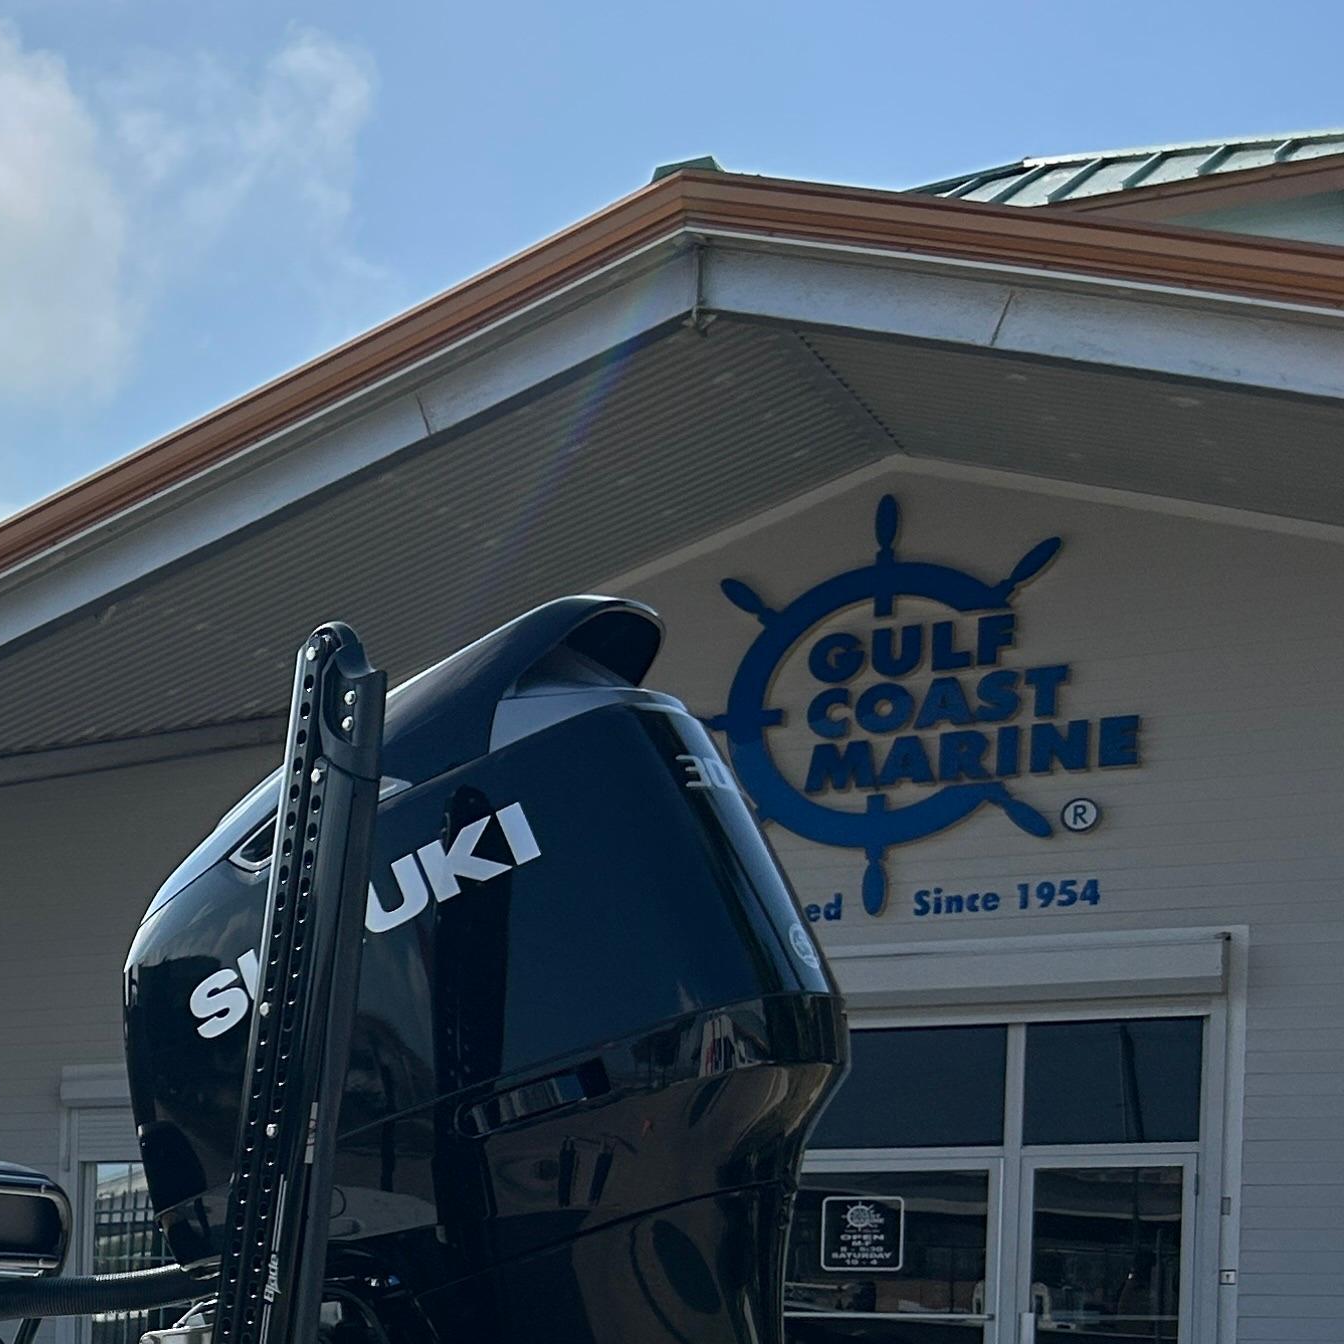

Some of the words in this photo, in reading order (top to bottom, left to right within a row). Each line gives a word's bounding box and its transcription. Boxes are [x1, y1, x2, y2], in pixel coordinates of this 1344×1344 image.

[808, 614, 1016, 684] GULF
[807, 664, 1069, 739] COAST
[805, 715, 1140, 793] MARINE
[190, 802, 541, 1038] SUKI
[913, 887, 1000, 917] Since
[1017, 879, 1101, 909] 1954
[840, 1233, 885, 1241] OPEN
[263, 1253, 282, 1302] Blade
